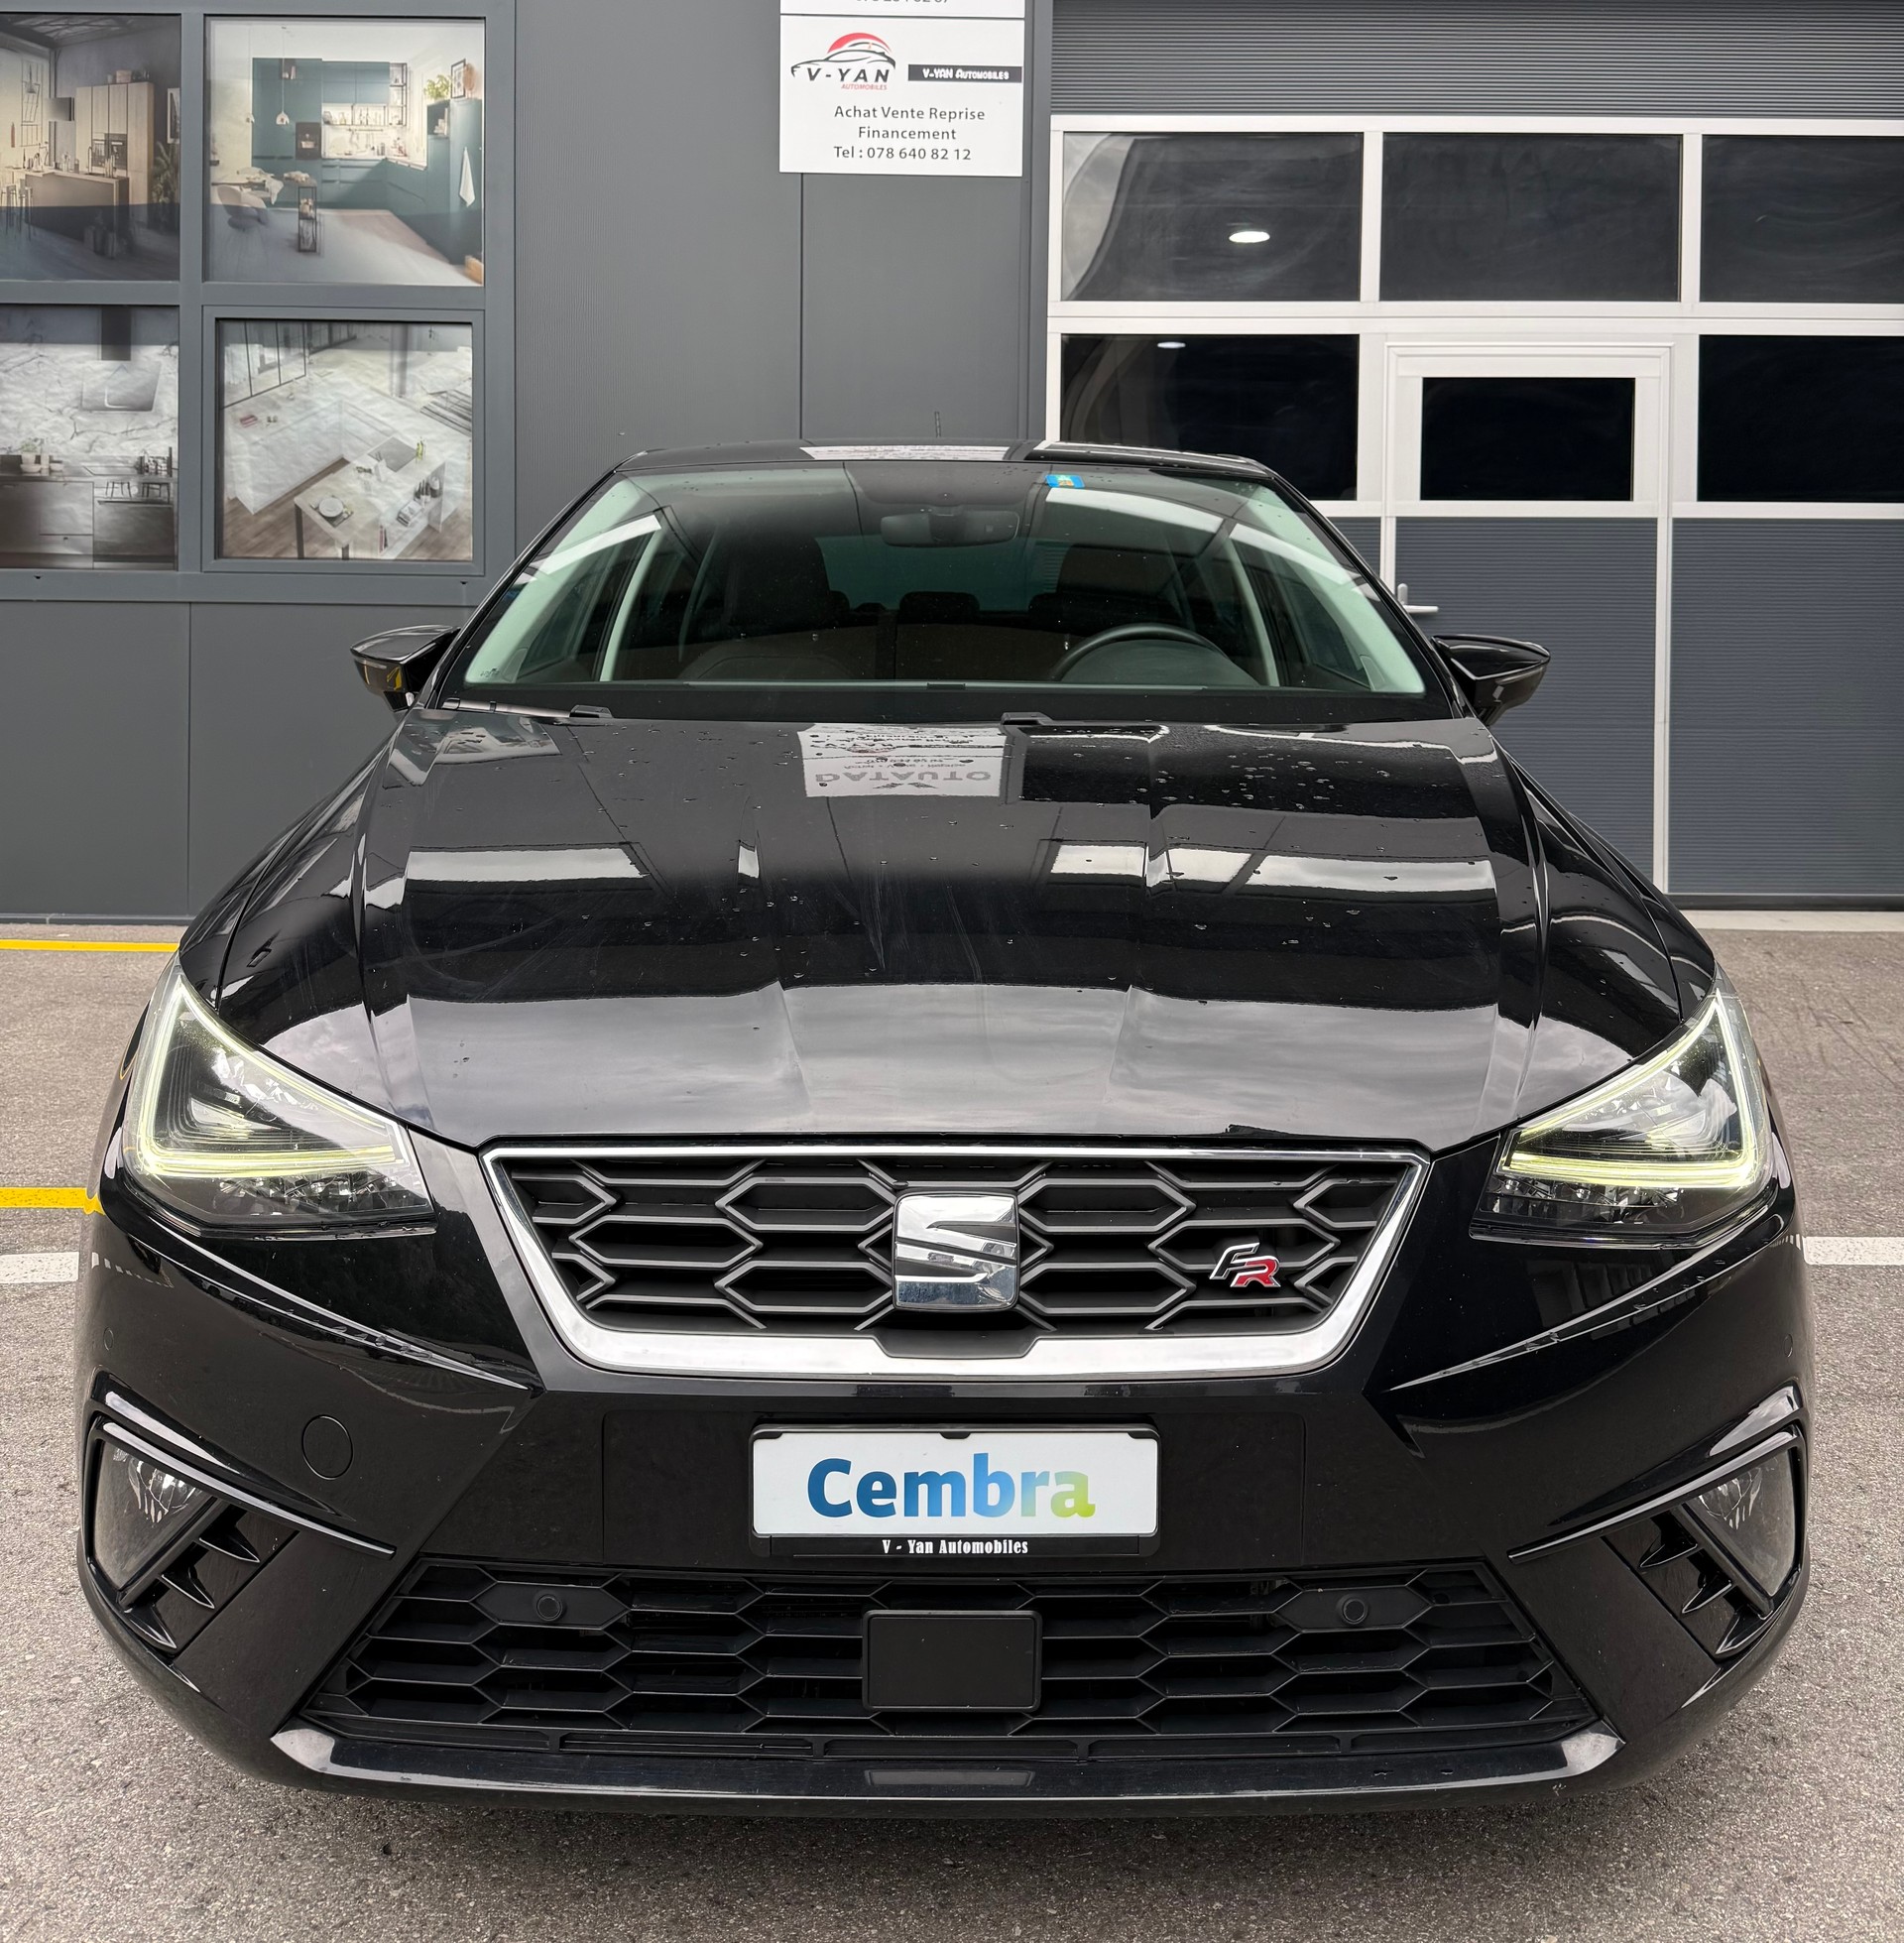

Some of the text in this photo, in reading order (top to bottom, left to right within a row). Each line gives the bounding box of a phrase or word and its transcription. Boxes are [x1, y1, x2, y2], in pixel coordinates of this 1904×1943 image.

[922, 67, 953, 79] V-YAN
[834, 106, 986, 123] Achat Vente Reprise
[858, 126, 957, 140] Financement
[834, 146, 855, 159] Tel
[867, 147, 894, 159] 078
[898, 148, 926, 160] 640
[930, 148, 949, 160] 82
[954, 149, 972, 161] 12
[1209, 1242, 1281, 1287] FR
[806, 1452, 1096, 1518] Cembra
[906, 1539, 934, 1554] Yan
[938, 1538, 1029, 1554] Automobiles
